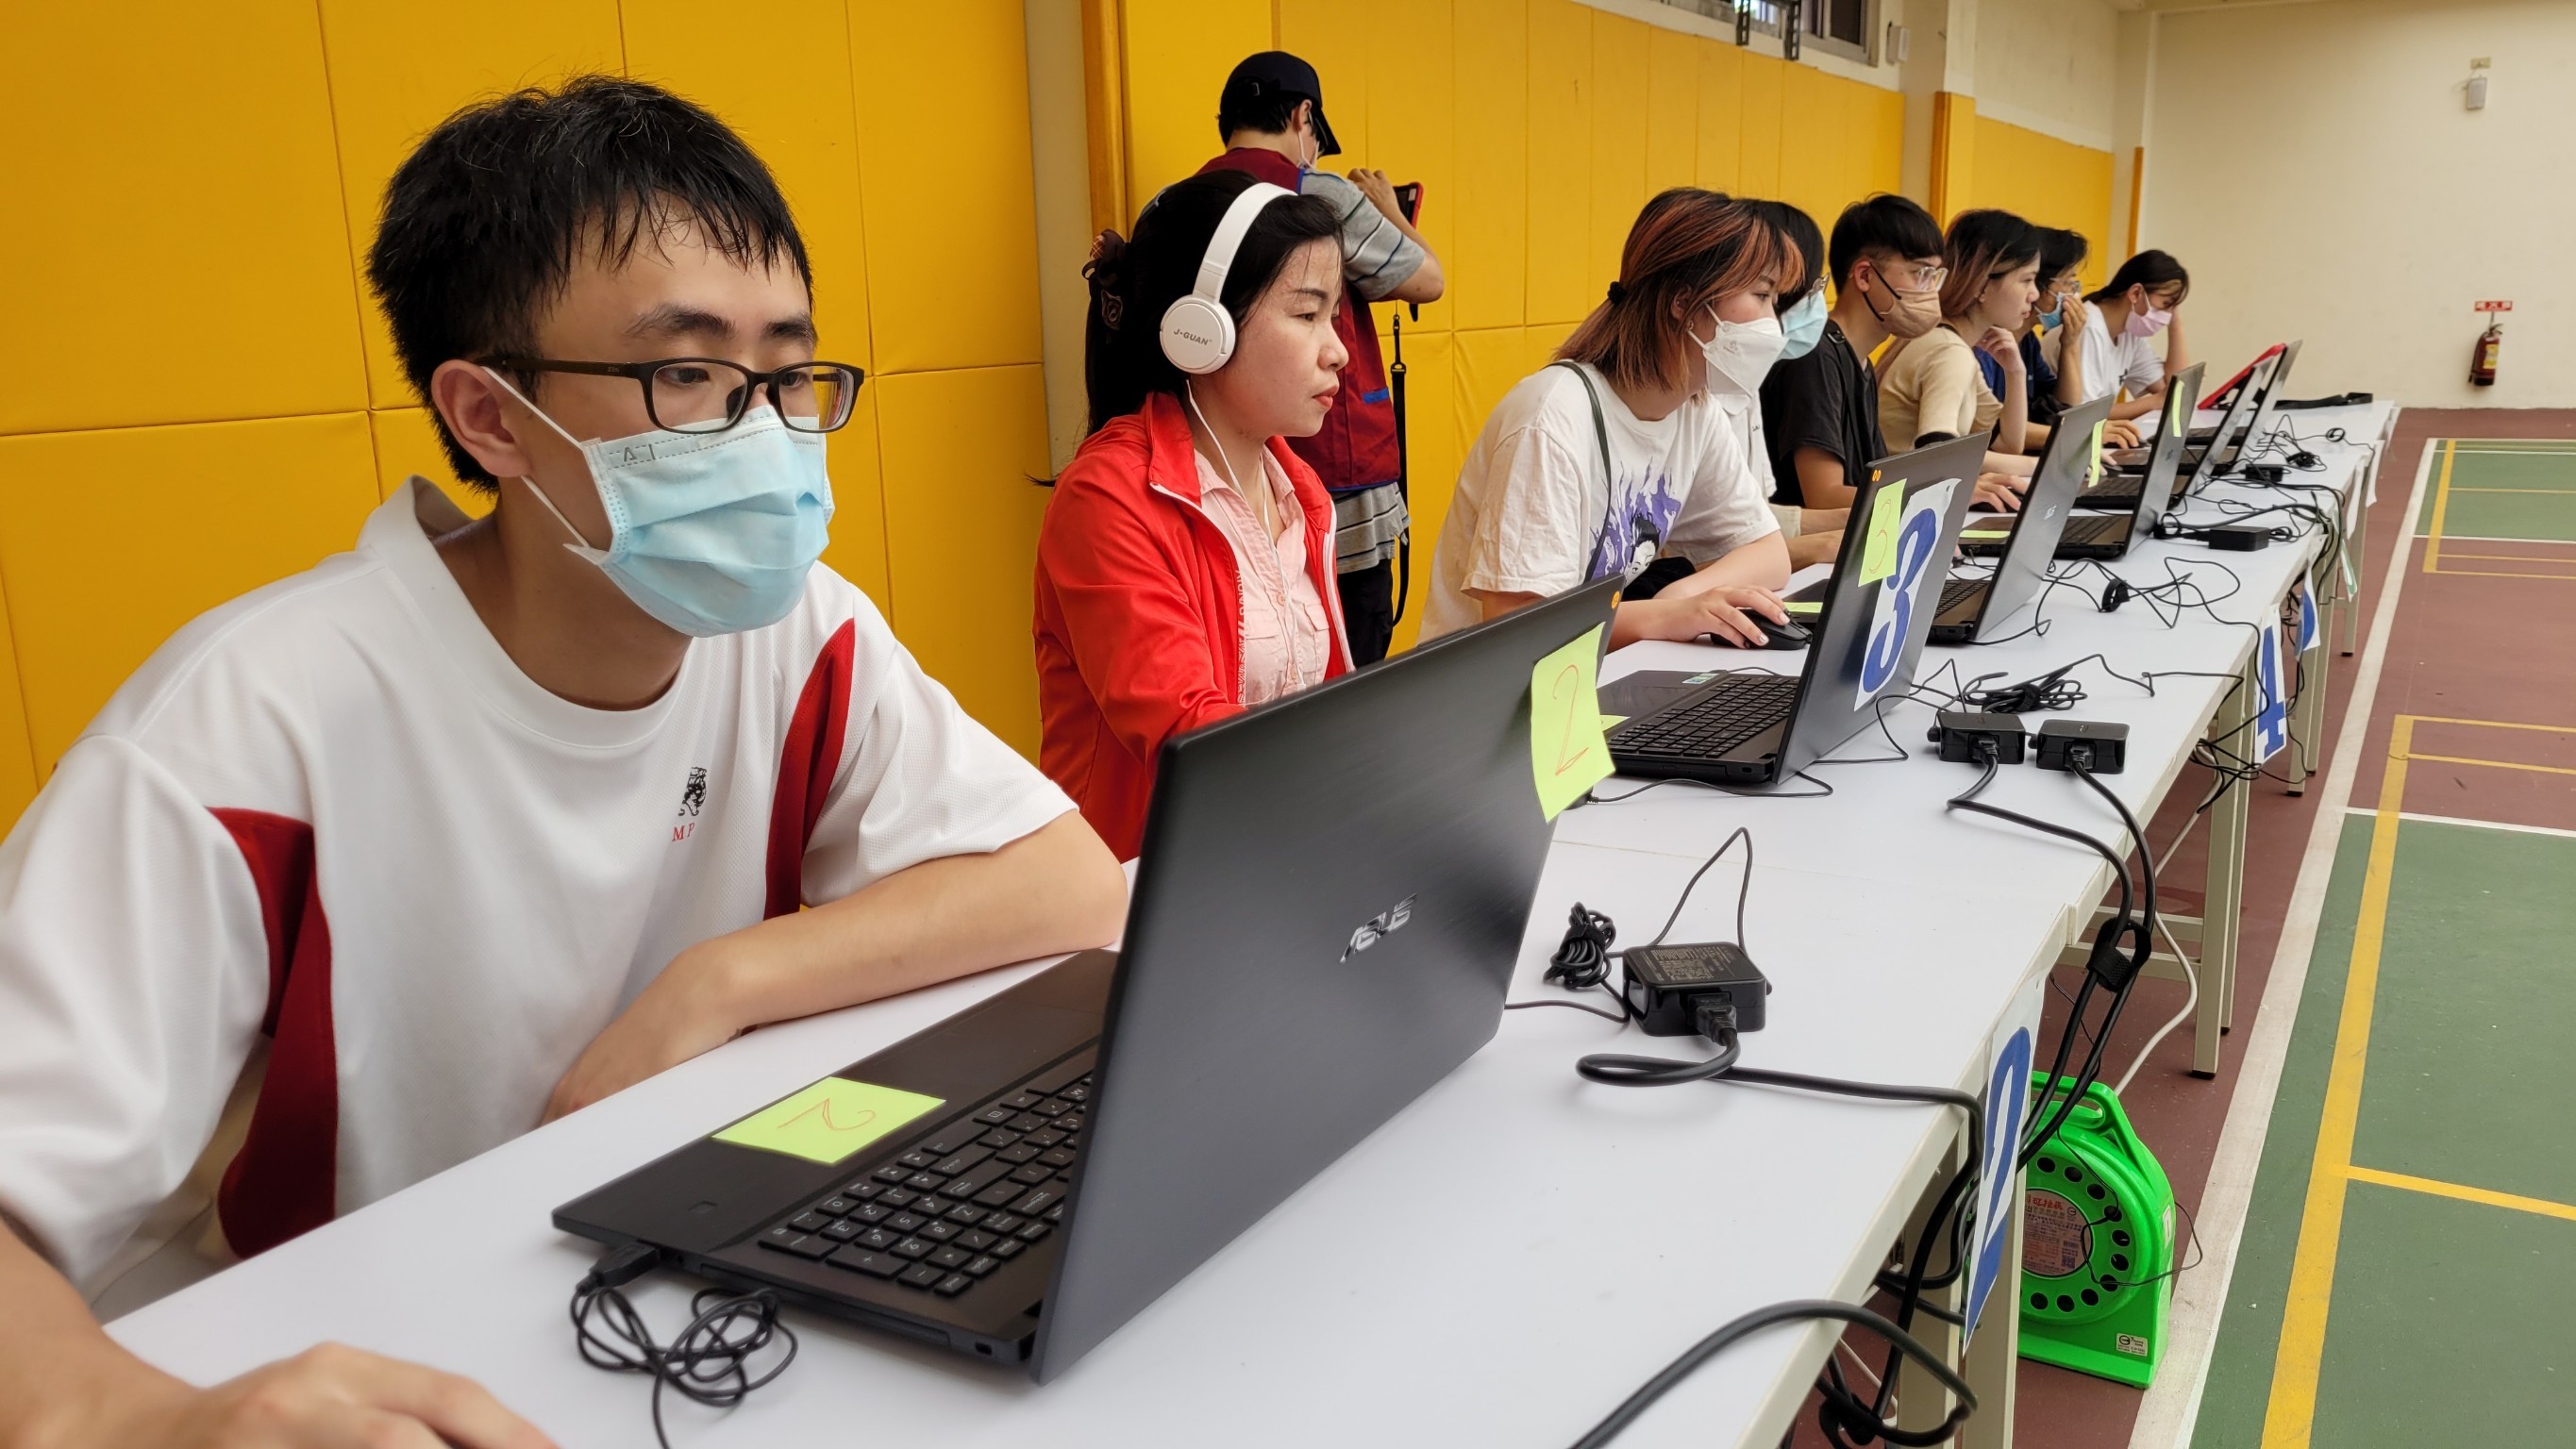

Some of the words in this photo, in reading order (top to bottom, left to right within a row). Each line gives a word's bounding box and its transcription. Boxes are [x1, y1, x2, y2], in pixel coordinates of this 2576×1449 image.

[1868, 498, 1893, 575] 3
[1862, 507, 1937, 693] 3
[1552, 663, 1590, 777] 2
[2256, 624, 2286, 761] 4
[1339, 891, 1418, 963] ASUS
[776, 1097, 878, 1132] 2
[1965, 1026, 2032, 1345] 2
